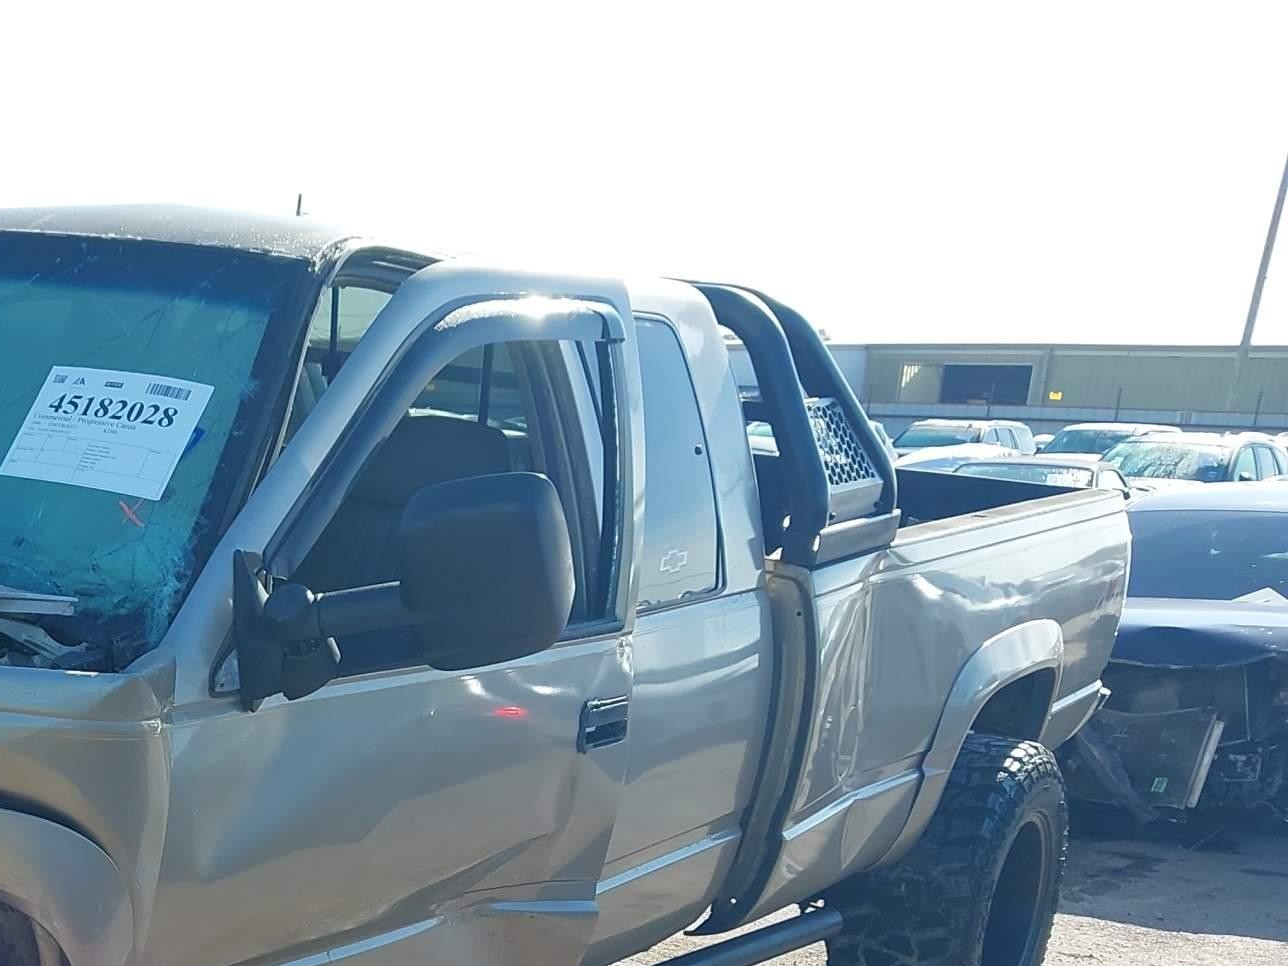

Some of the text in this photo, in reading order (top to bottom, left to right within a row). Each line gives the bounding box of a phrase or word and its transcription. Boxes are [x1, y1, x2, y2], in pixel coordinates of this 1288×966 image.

[33, 413, 73, 422] Commercial
[77, 417, 115, 428] Progressive
[48, 393, 179, 428] 45182028
